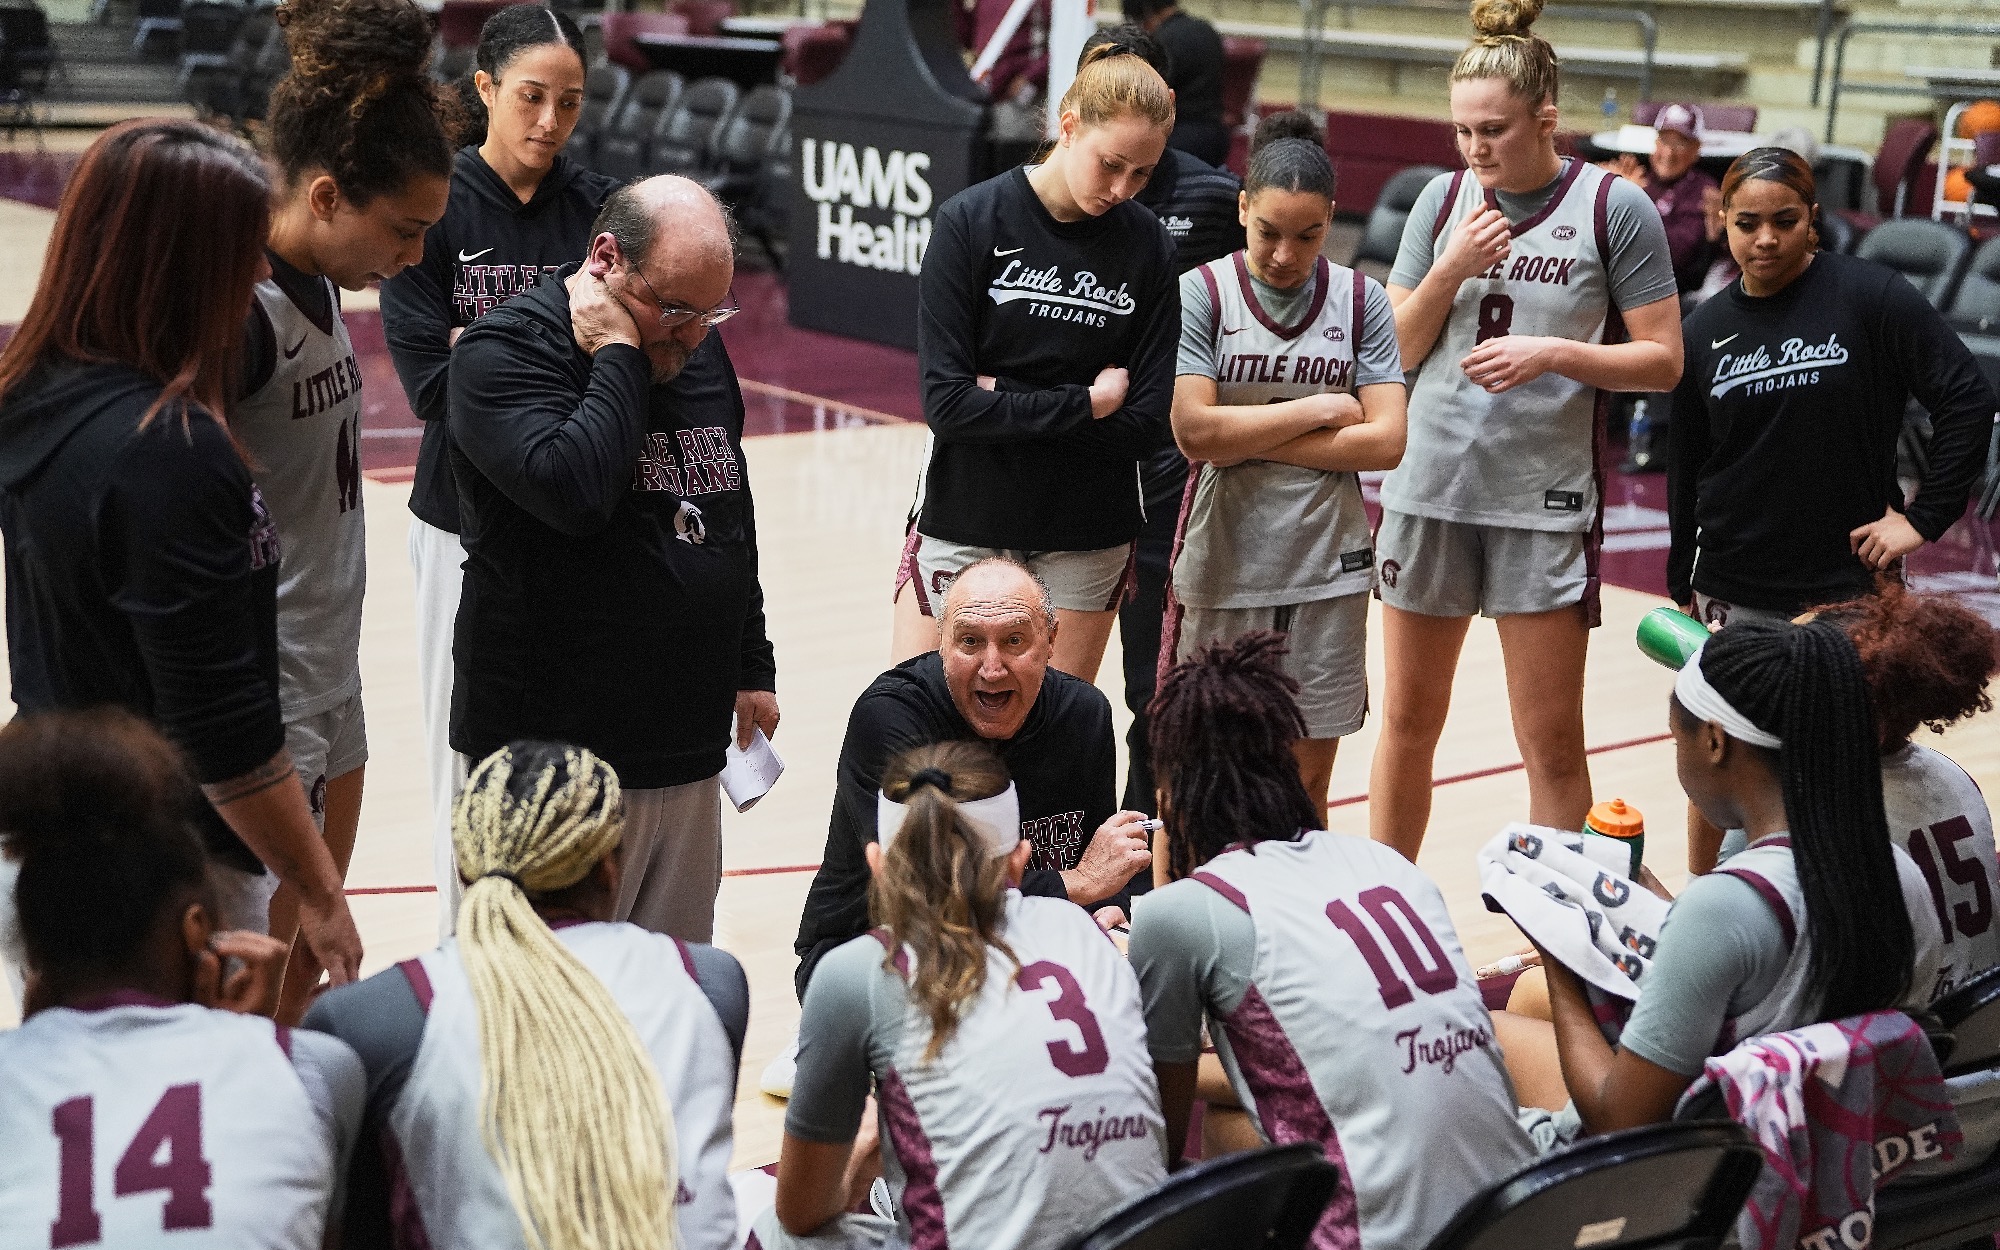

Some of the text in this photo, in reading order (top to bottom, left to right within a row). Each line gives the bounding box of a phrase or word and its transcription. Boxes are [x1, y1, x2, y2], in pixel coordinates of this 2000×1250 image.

[802, 138, 933, 217] UAMS
[992, 259, 1132, 307] Little Rock
[1508, 256, 1576, 286] ROCK
[1029, 303, 1107, 328] TROJANS
[1217, 353, 1352, 387] LITTLE ROCK
[1712, 333, 1841, 383] Little Rock
[1745, 371, 1820, 397] TROJANS
[292, 360, 348, 420] LITTLE
[1022, 810, 1084, 849] ROCK
[1907, 815, 1992, 944] 15
[1325, 885, 1458, 1011] 10
[1016, 961, 1109, 1077] 3
[1038, 1103, 1147, 1161] Trojans
[49, 1081, 213, 1249] 14
